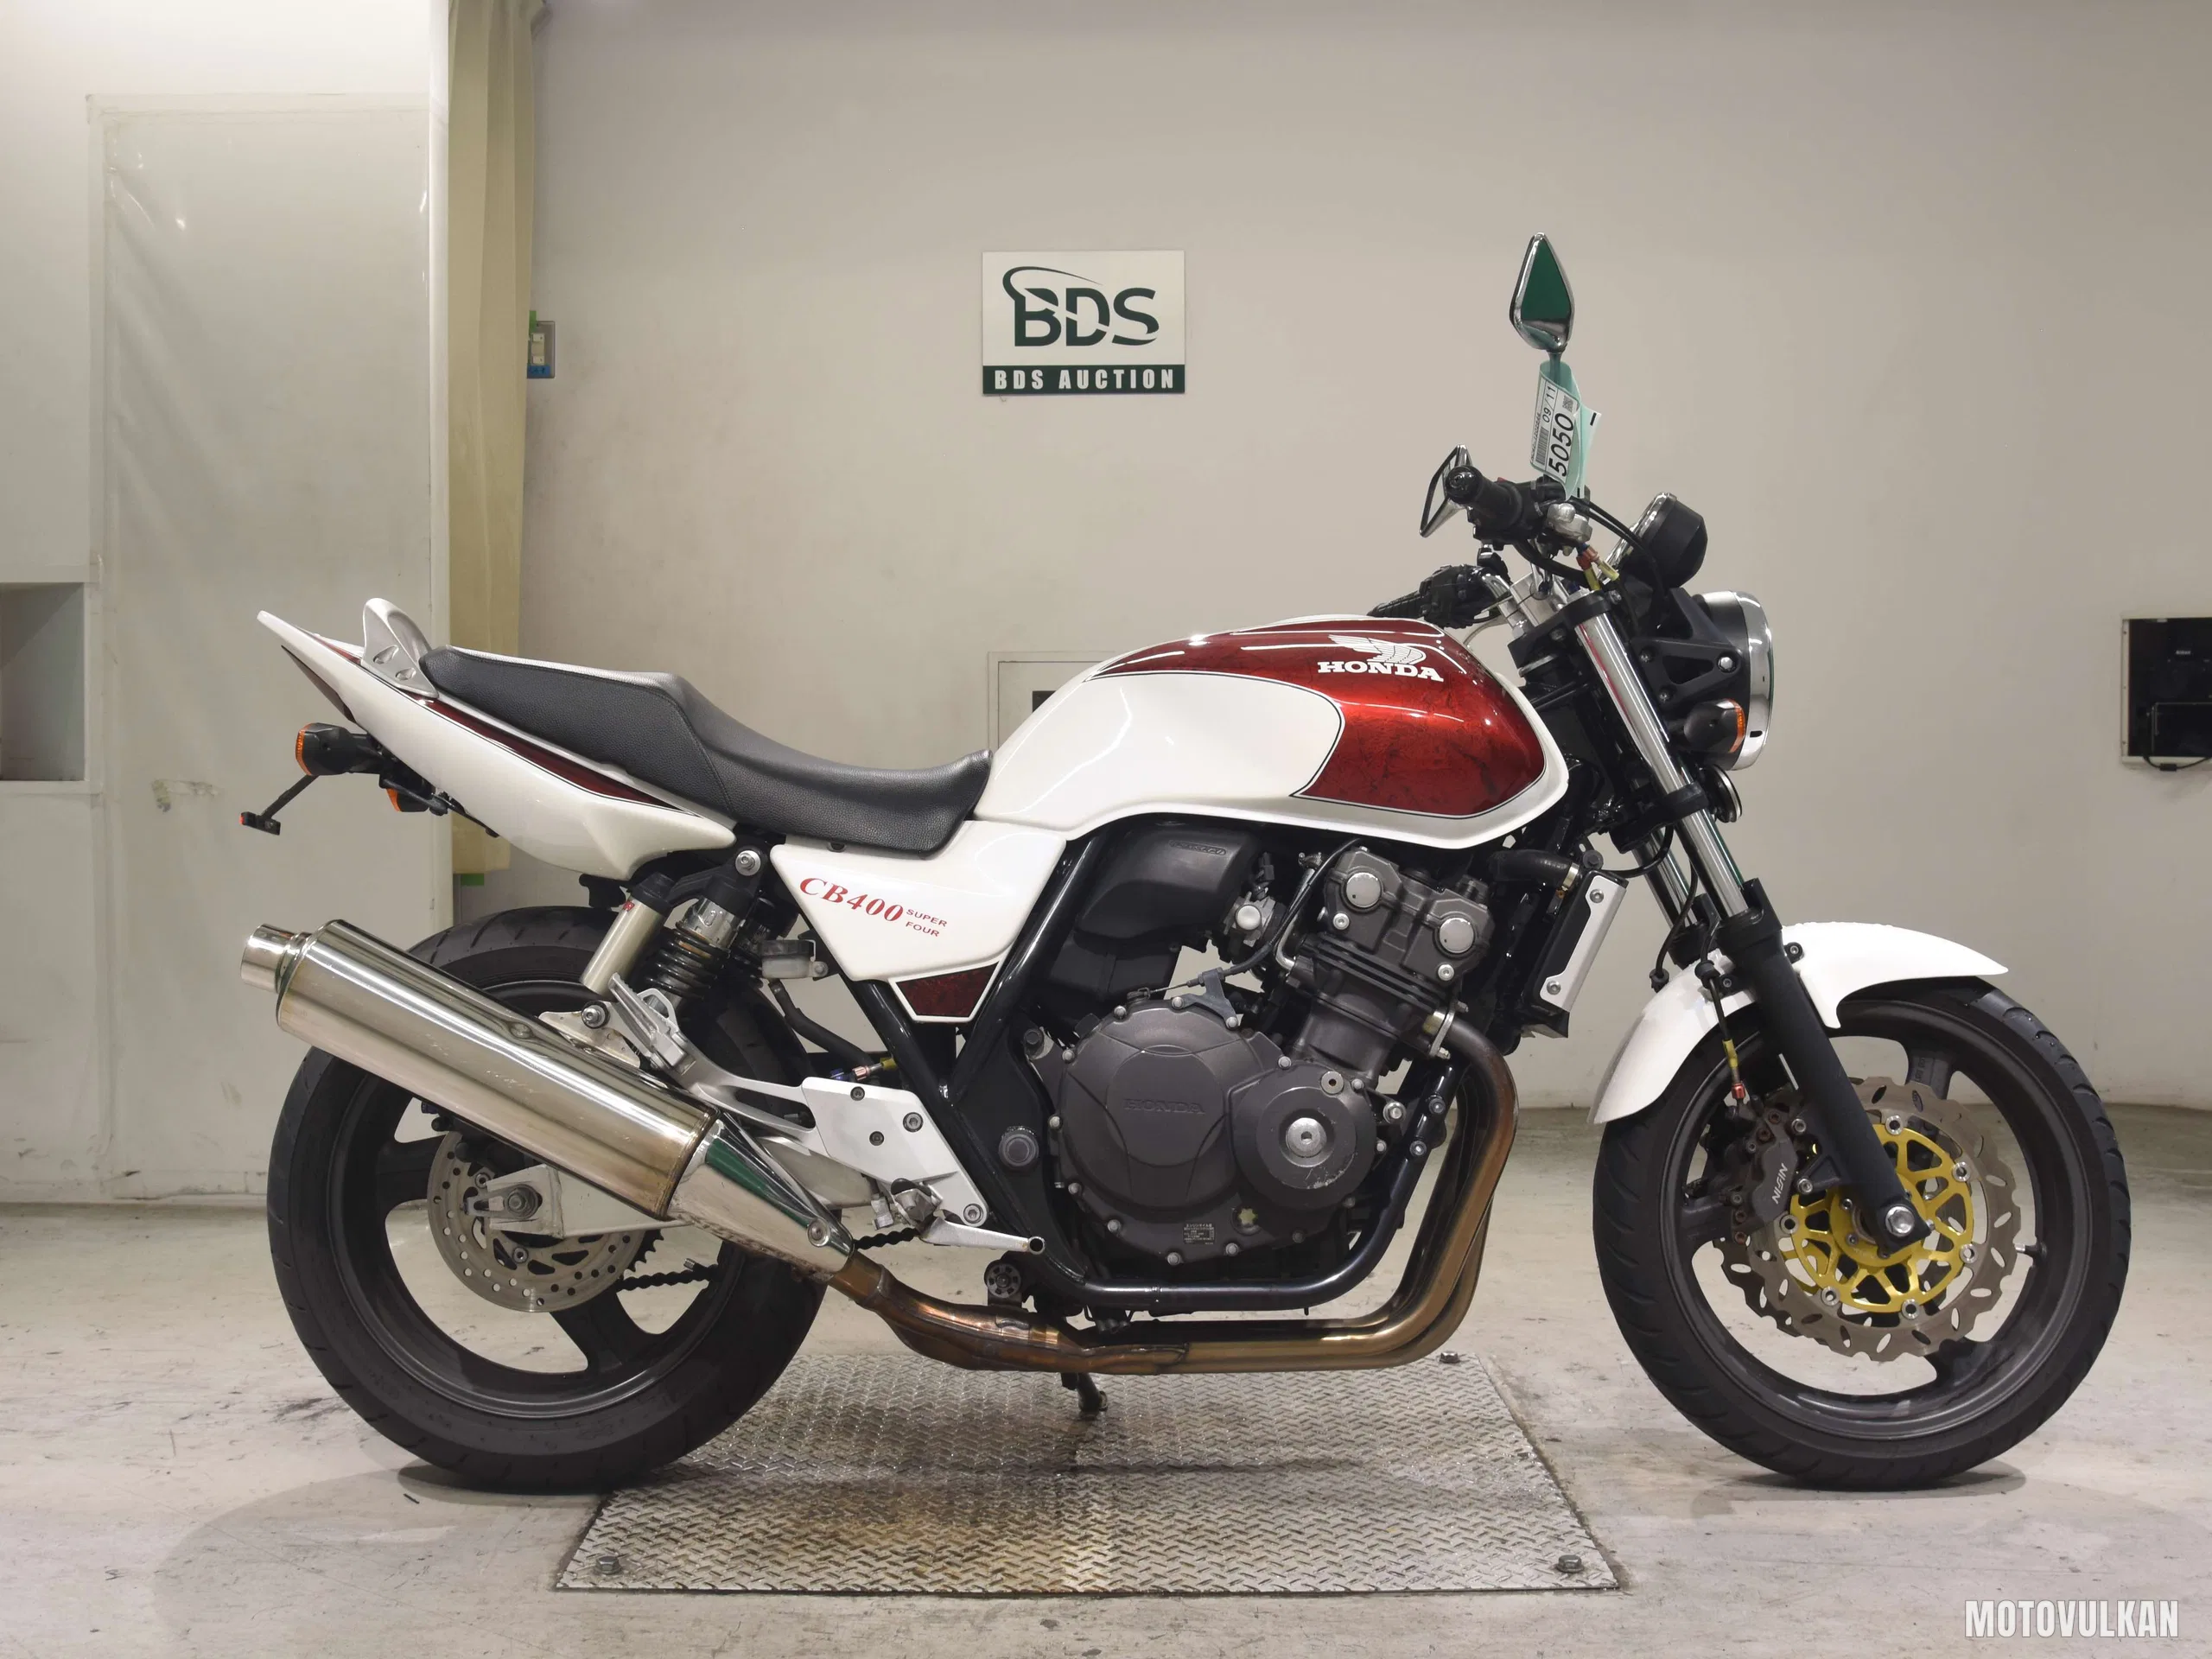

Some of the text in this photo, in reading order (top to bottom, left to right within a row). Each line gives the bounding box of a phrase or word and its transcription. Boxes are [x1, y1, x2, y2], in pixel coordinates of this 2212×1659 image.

[1002, 266, 1160, 346] BDS
[995, 369, 1173, 390] BDS AUCTION
[1541, 385, 1556, 423] 09/11
[1548, 413, 1574, 477] 5050
[1318, 661, 1444, 682] HONDA
[799, 877, 948, 927] CB400 SUPER
[906, 921, 940, 937] FOUR
[1123, 1098, 1205, 1116] HONDA
